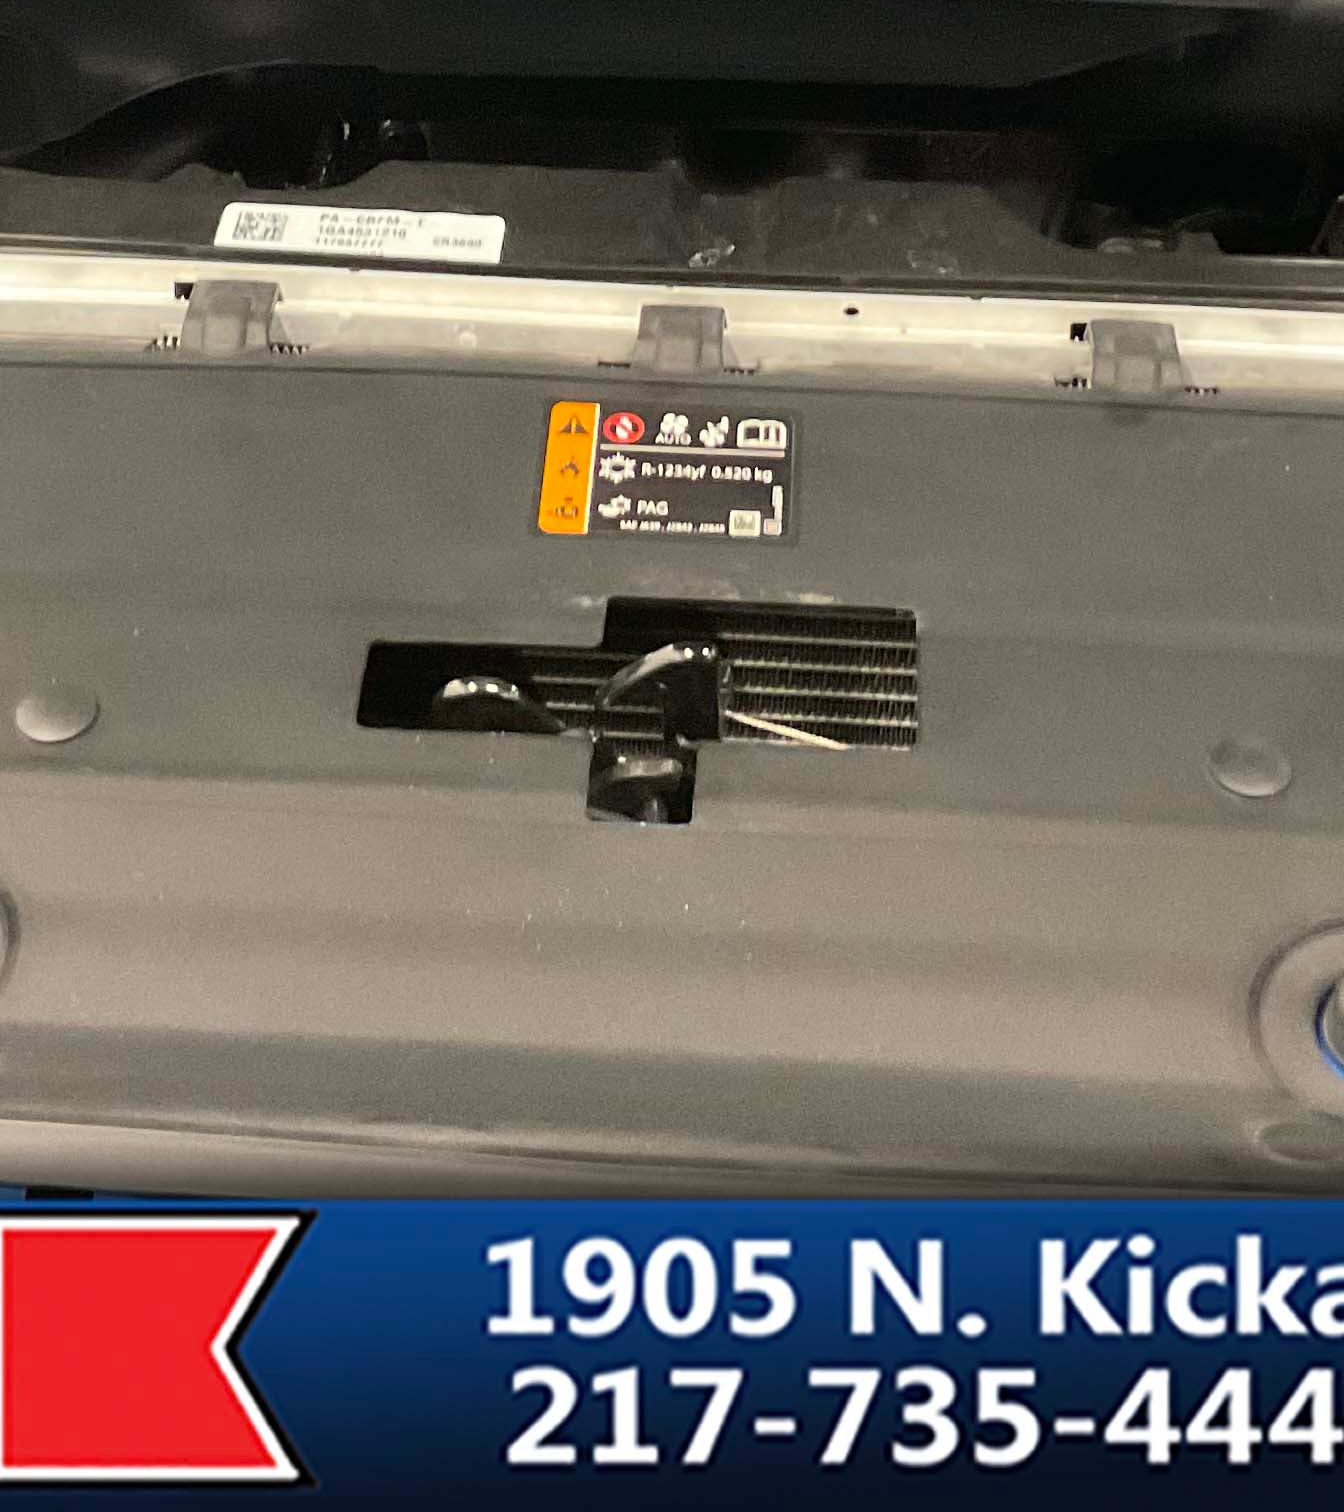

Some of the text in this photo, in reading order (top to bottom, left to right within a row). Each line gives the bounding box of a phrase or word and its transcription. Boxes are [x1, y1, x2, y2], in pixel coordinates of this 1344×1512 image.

[655, 432, 692, 445] AUTO
[754, 466, 773, 484] kg
[636, 499, 669, 516] PAG
